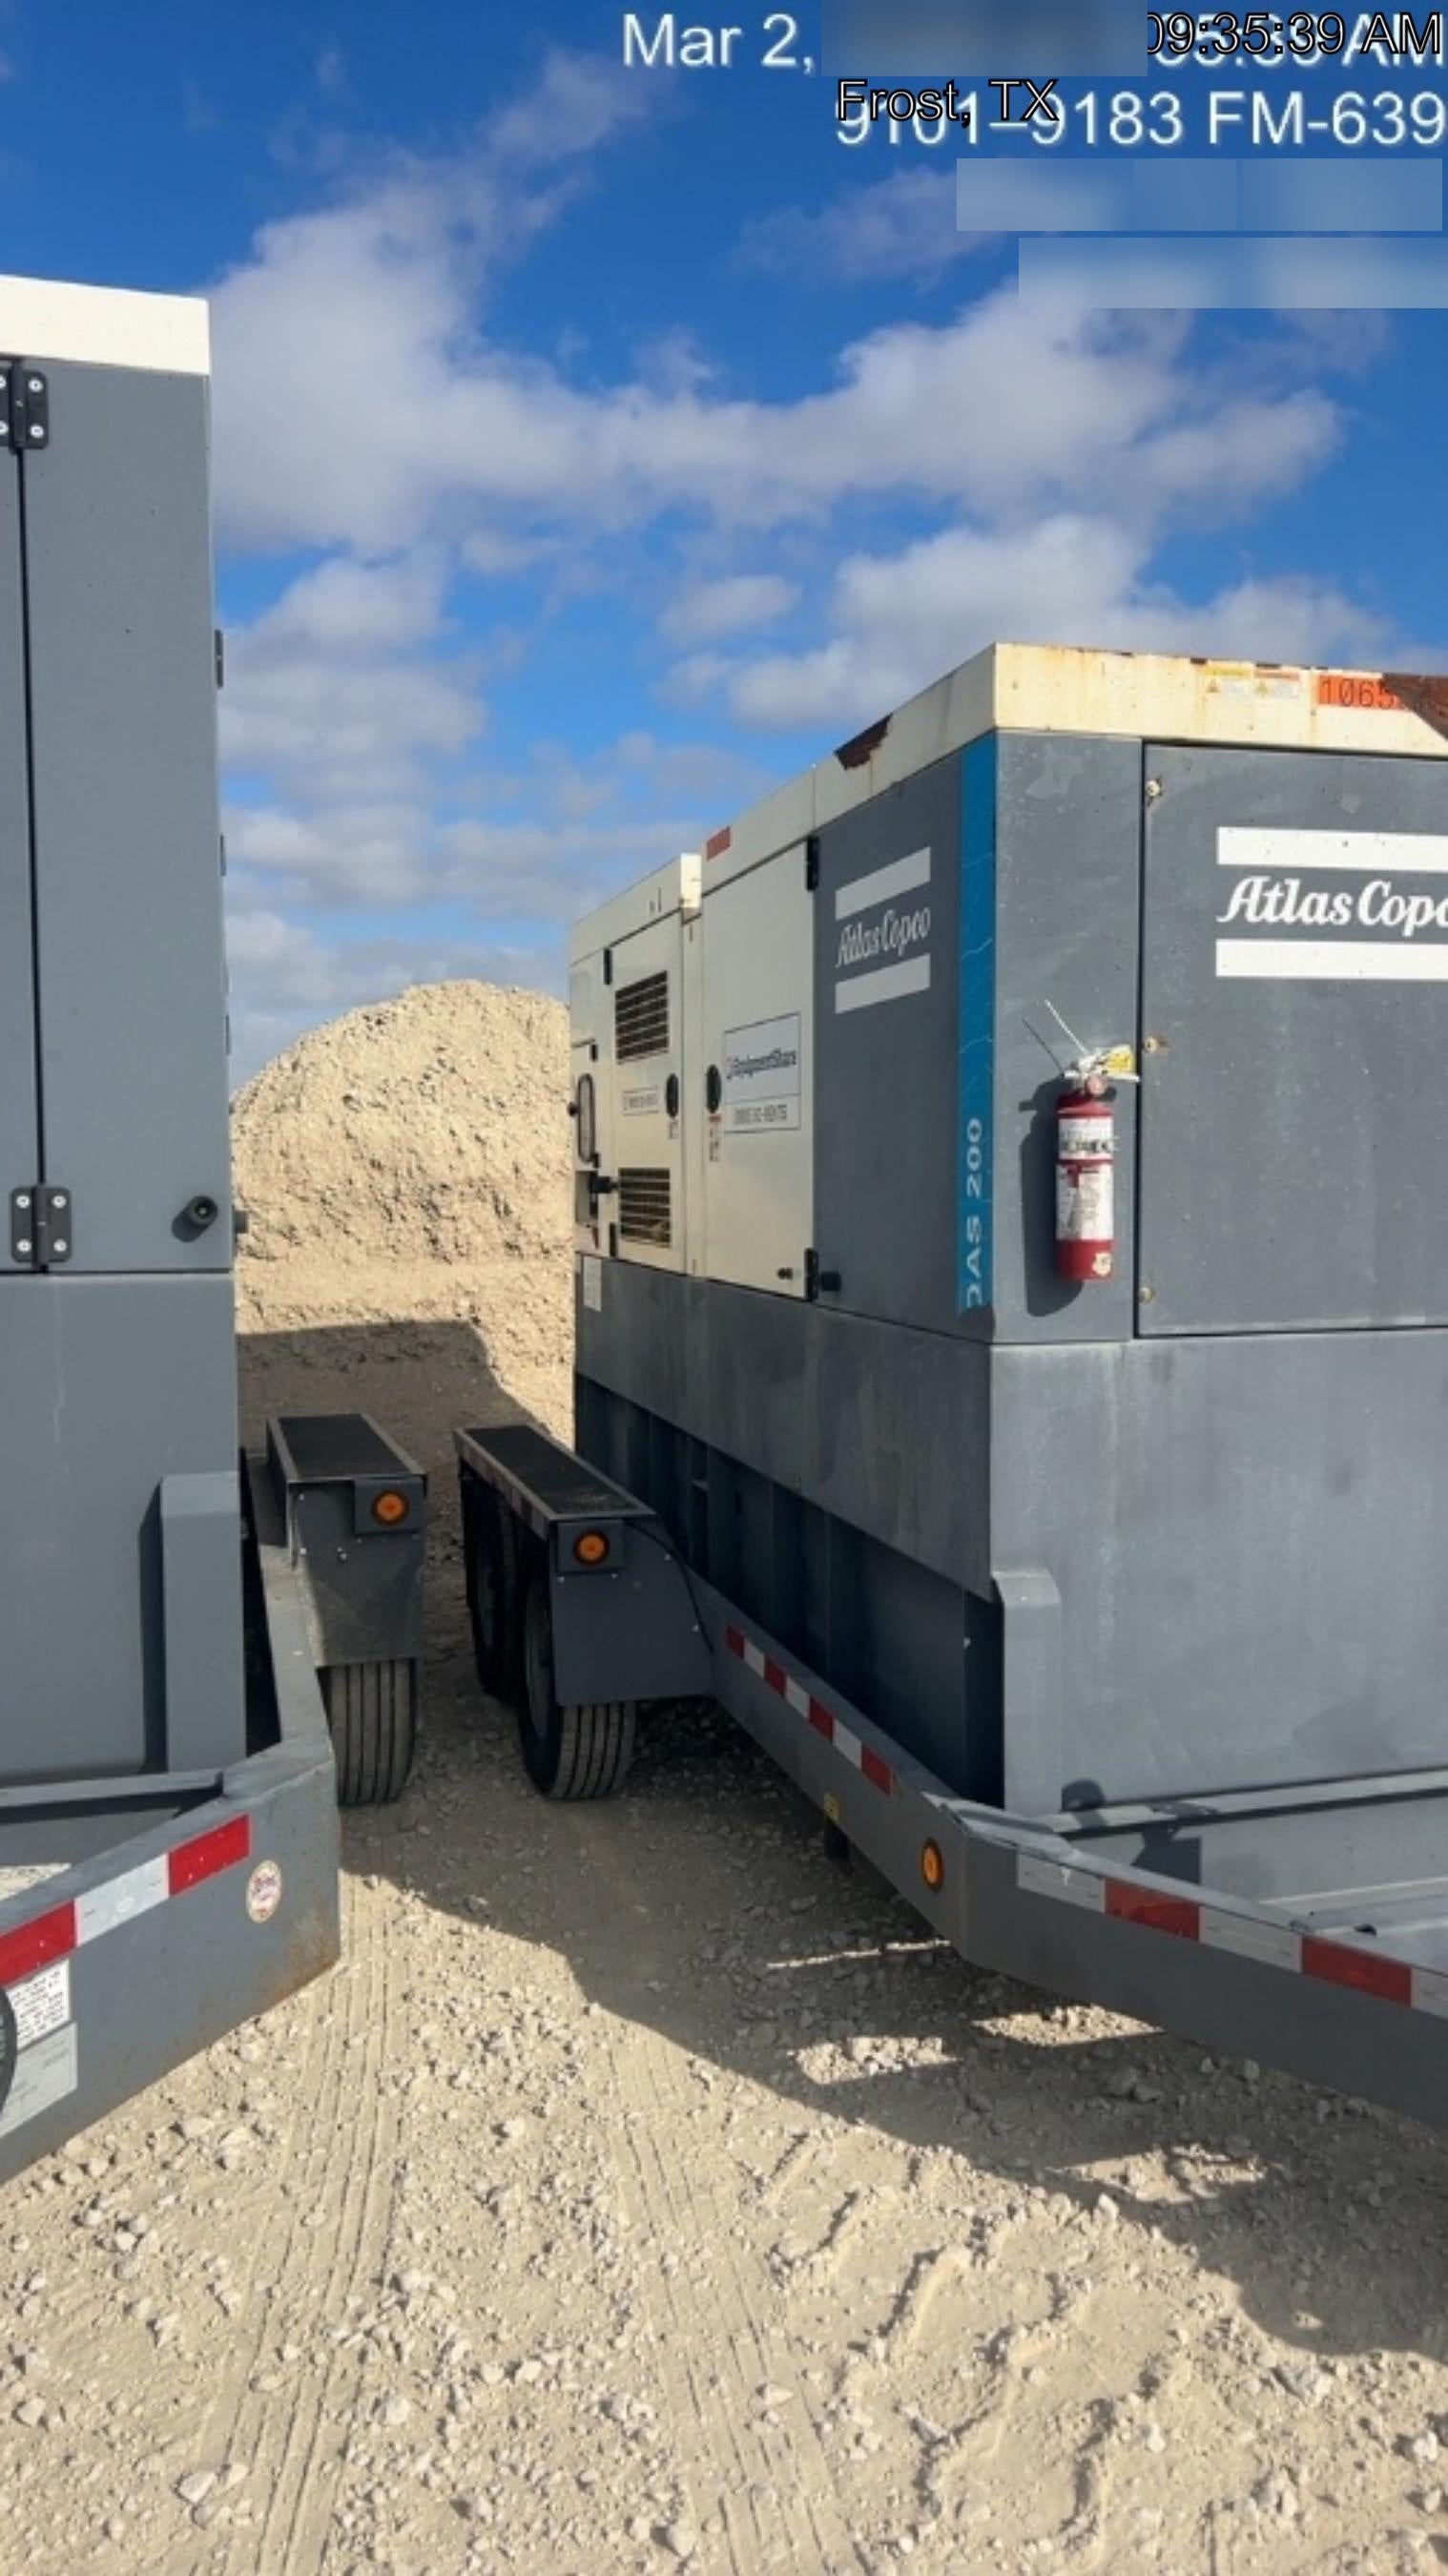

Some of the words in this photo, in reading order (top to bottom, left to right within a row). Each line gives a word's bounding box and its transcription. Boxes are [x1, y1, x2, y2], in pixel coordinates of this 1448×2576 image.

[1215, 875, 1354, 925] Atlas
[835, 922, 879, 968] Atlas
[880, 906, 932, 957] Copco
[966, 1117, 983, 1198] 200
